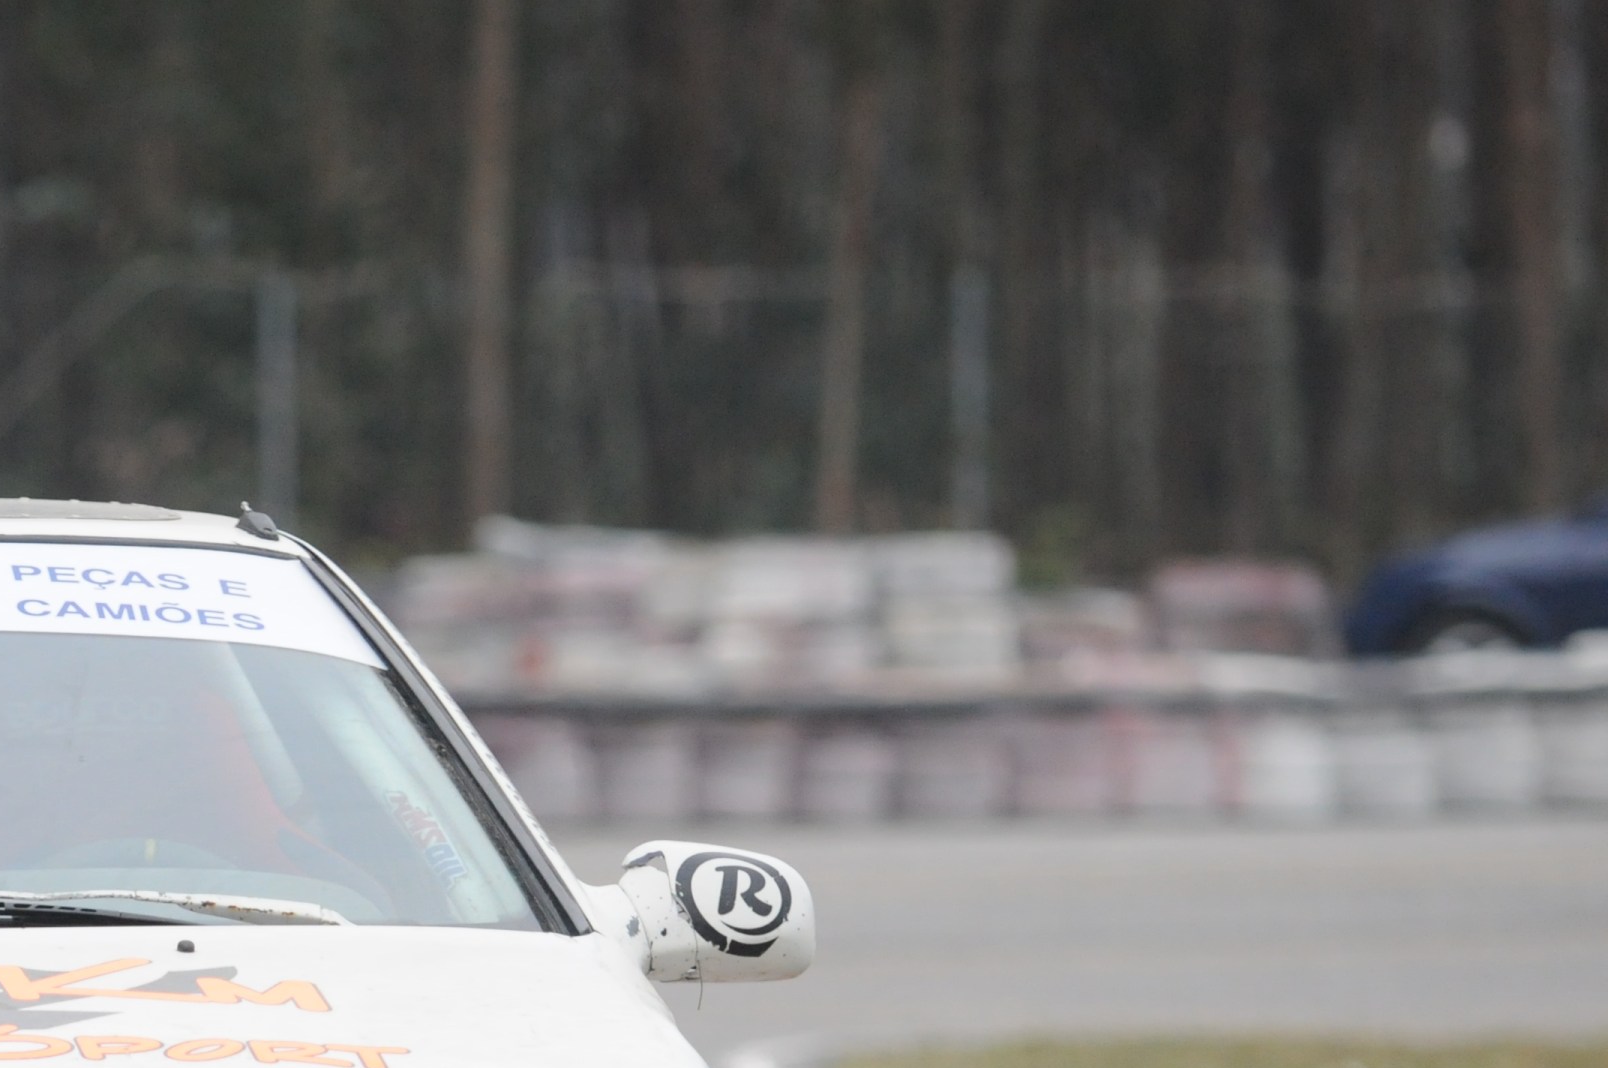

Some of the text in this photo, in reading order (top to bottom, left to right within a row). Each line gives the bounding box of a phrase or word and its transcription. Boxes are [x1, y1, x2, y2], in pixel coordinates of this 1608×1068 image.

[11, 564, 252, 598] PEÇAS E
[17, 599, 266, 632] CAMIÕES
